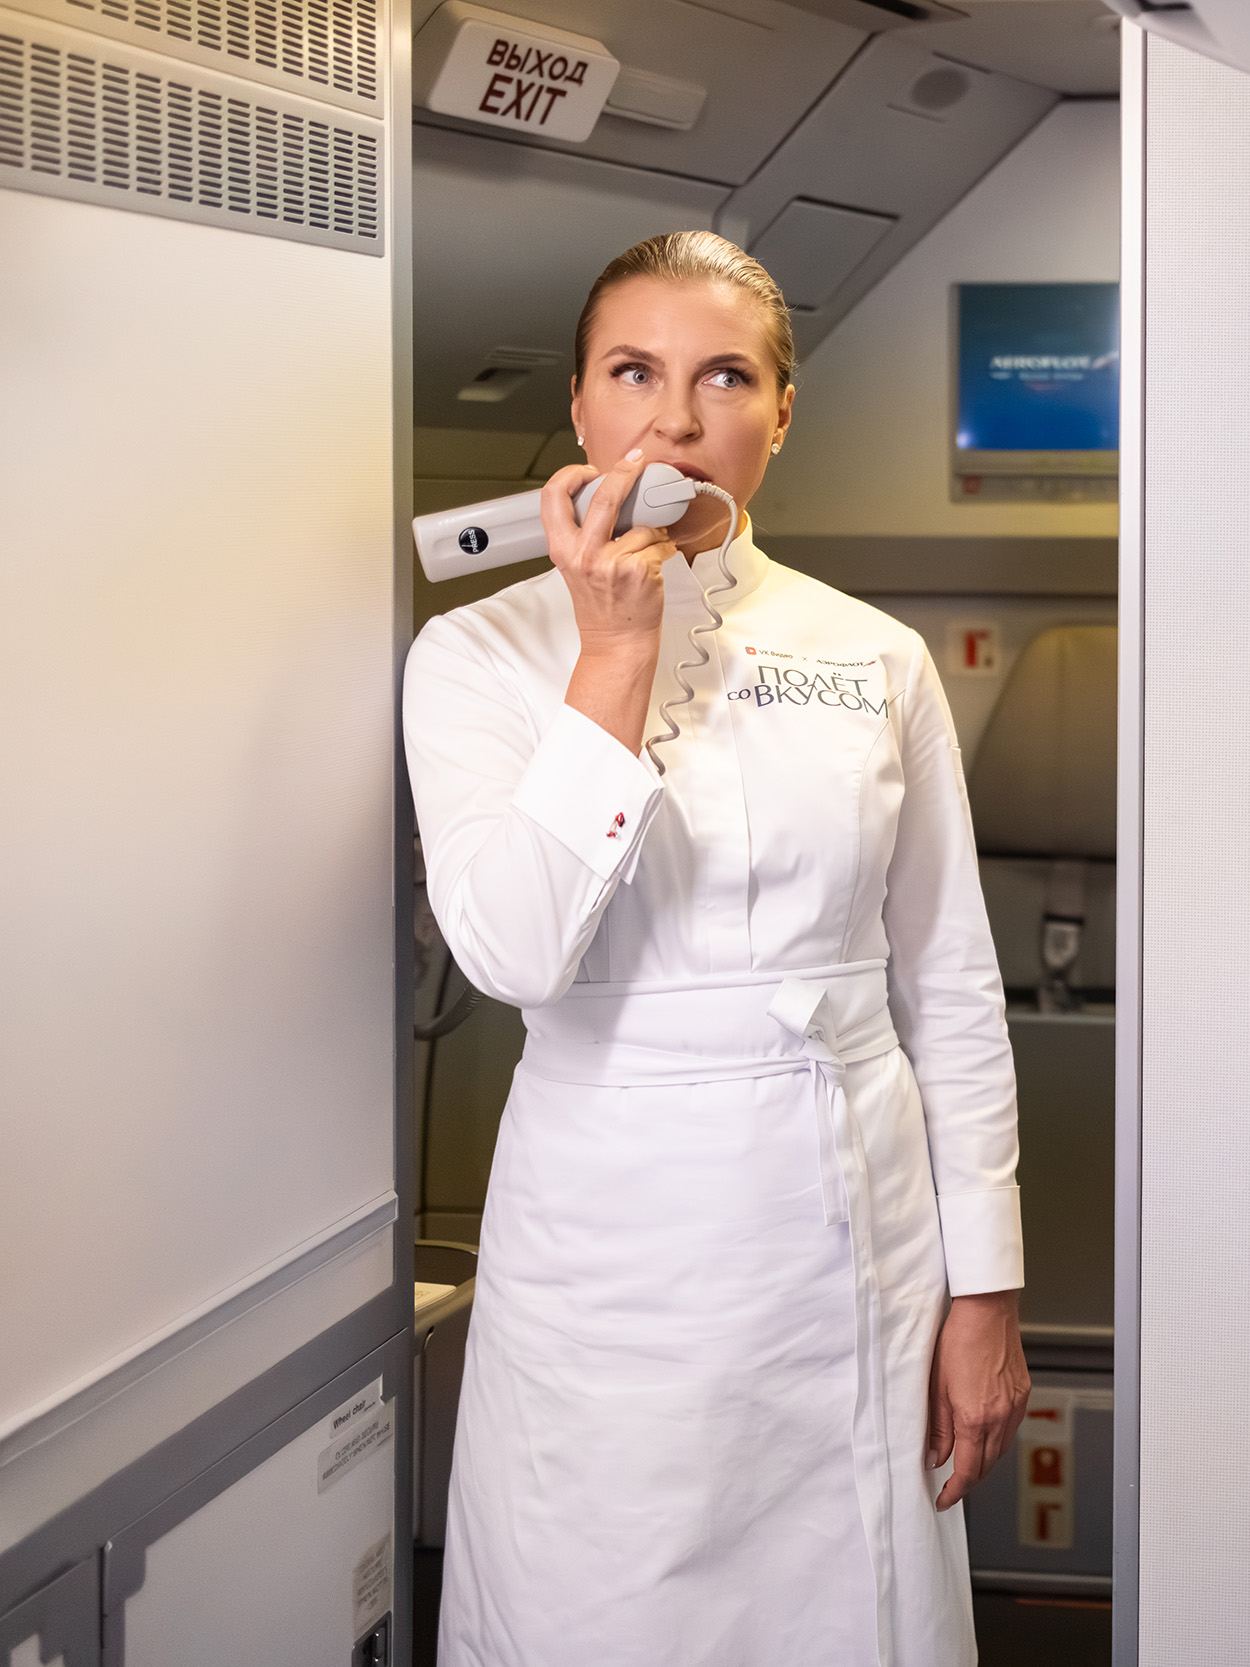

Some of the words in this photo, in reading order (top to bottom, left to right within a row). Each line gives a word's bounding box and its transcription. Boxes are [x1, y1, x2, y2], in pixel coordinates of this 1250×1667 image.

[486, 39, 588, 87] ВЫХОД
[479, 73, 568, 125] EXIT
[468, 530, 479, 552] PRESS
[758, 666, 867, 696] ПОЛЁТ
[754, 683, 889, 718] ВКУСОМ
[333, 1410, 351, 1429] Wheel
[352, 1400, 366, 1415] chair
